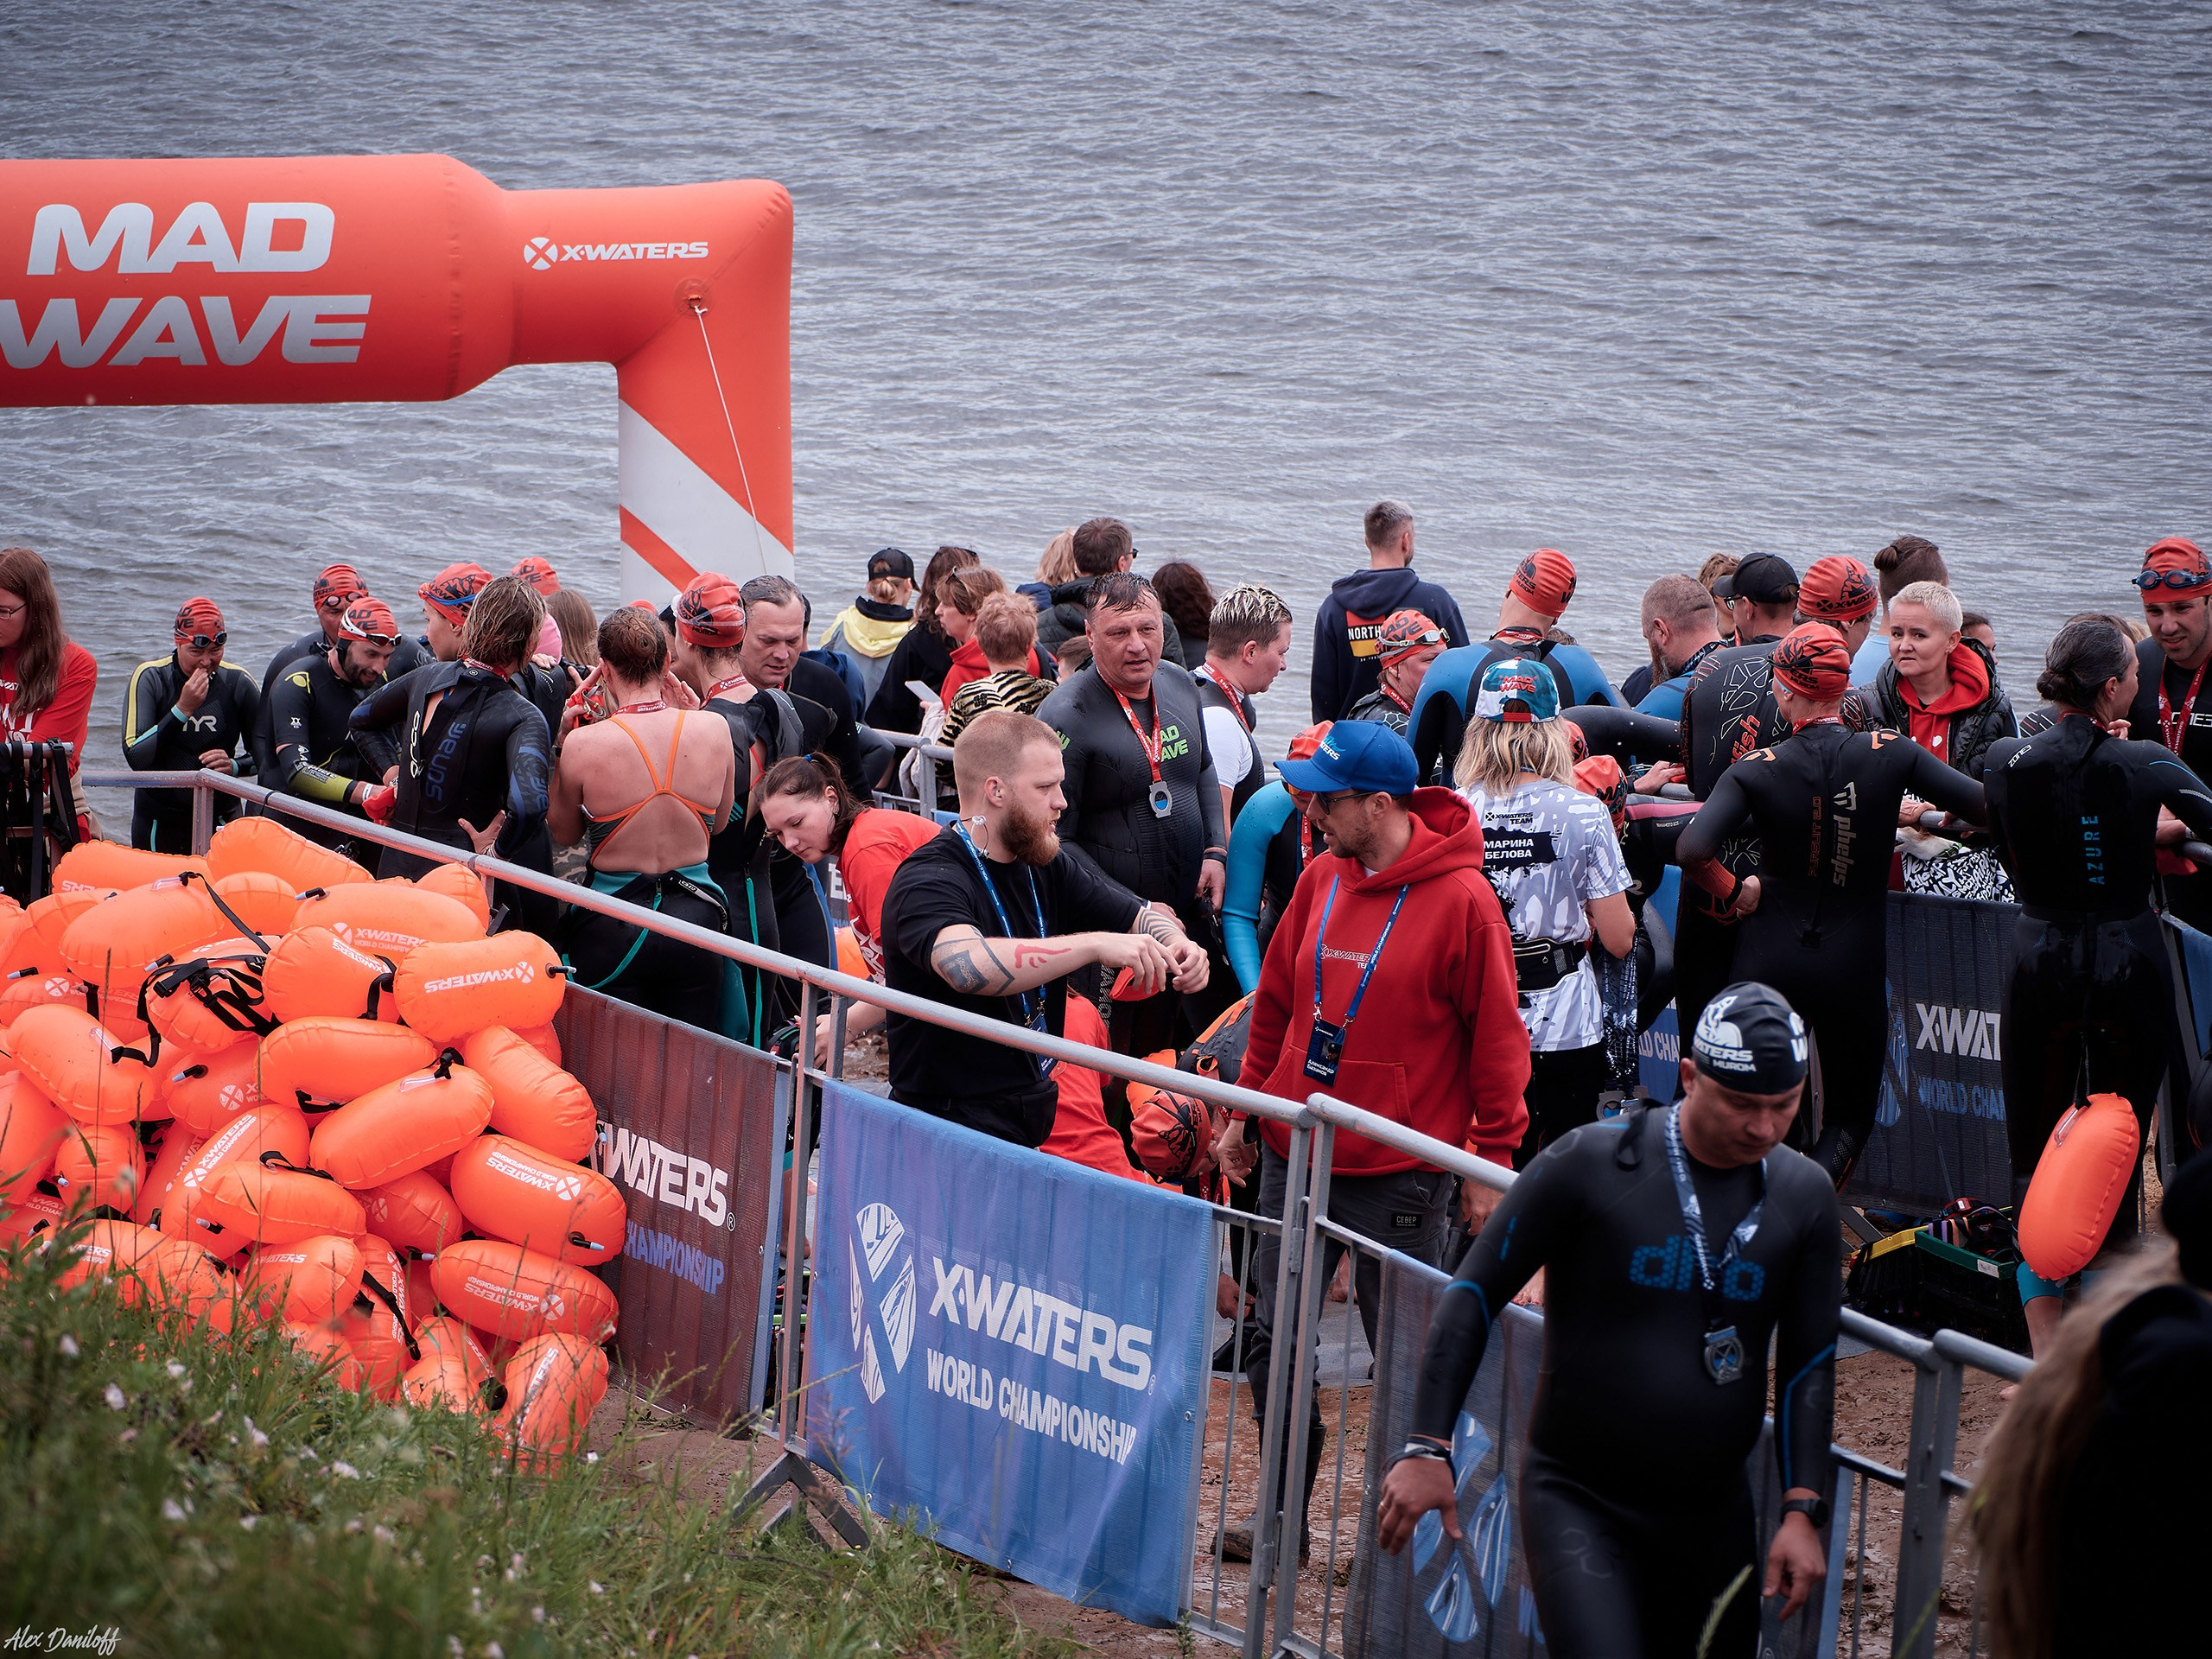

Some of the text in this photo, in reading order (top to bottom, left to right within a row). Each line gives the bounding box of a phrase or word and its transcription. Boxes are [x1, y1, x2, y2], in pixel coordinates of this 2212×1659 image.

[27, 202, 335, 275] MAD
[0, 295, 372, 370] WAVE
[1348, 625, 1381, 640] NORTH
[1499, 683, 1536, 693] WAVE
[1502, 675, 1534, 684] MAD
[410, 710, 421, 779] orca
[1484, 838, 1535, 849] МАРИНА
[1484, 849, 1533, 860] БЕЛОВА
[1831, 814, 1857, 887] phelps
[2081, 816, 2105, 885] AZURE
[354, 939, 377, 949] WORLD
[1654, 1032, 1681, 1063] CHA
[1712, 1058, 1757, 1072] MUROM
[1918, 1075, 1968, 1116] WORLD
[206, 1152, 225, 1170] WORLD
[222, 1116, 257, 1154] CHAMPIONSHIP
[492, 1151, 558, 1182] WORLD CHAMPIONSHIP
[516, 1291, 539, 1303] WORLD
[927, 1347, 1137, 1465] WORLD CHAMPIONSHIP
